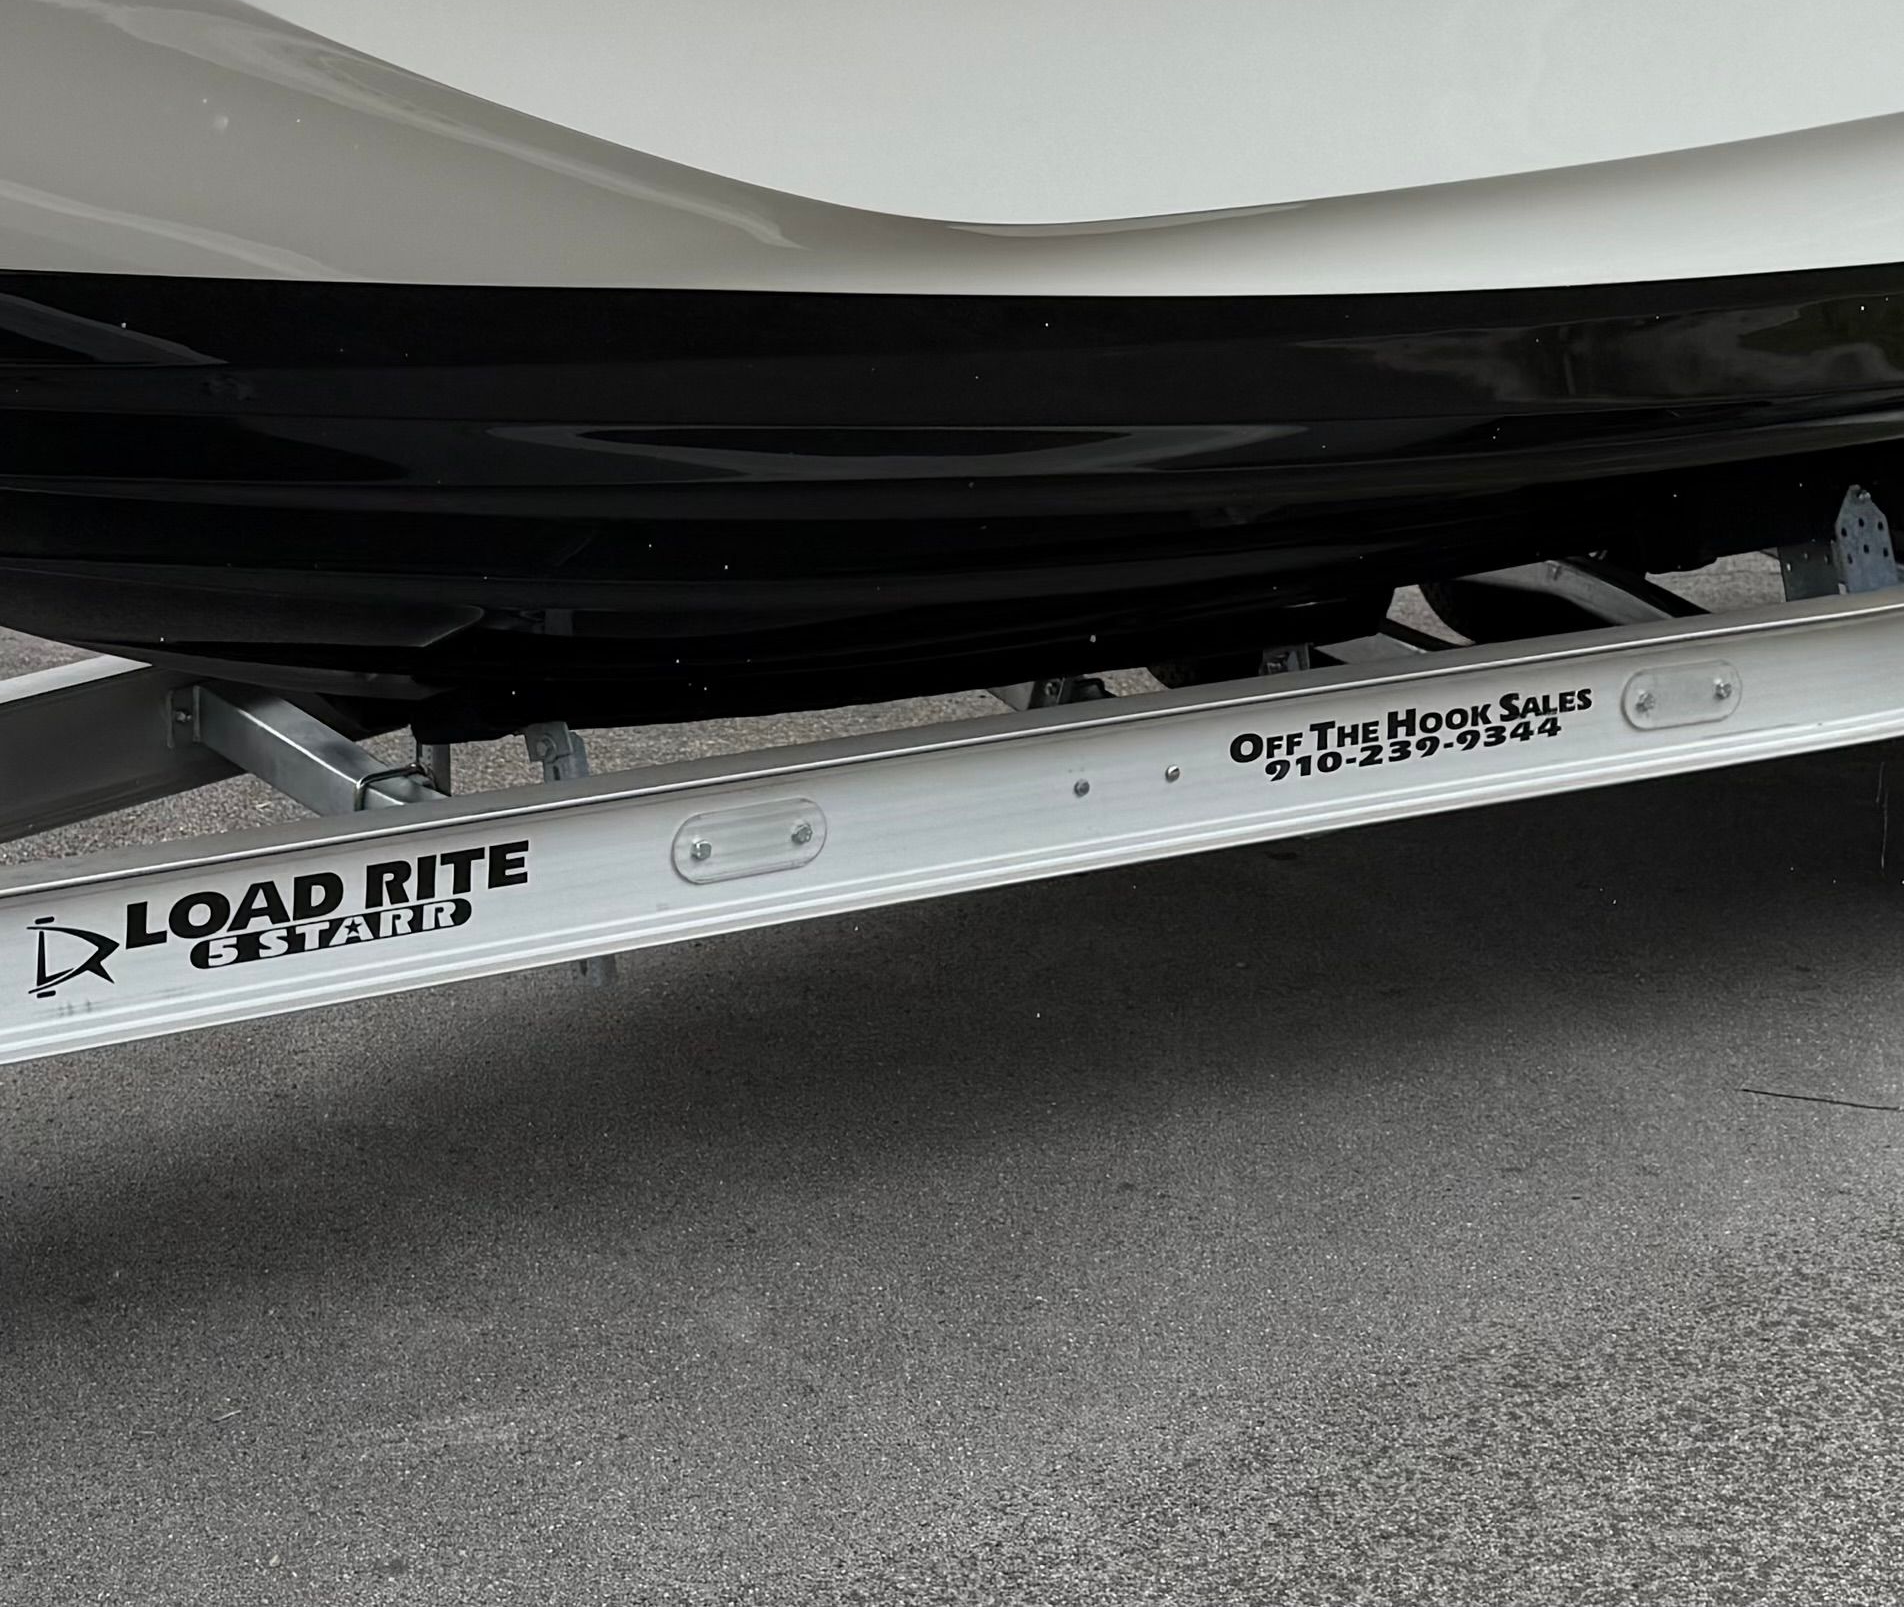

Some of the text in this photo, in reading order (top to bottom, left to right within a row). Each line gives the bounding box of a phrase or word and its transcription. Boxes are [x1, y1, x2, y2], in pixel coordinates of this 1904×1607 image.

[1230, 689, 1593, 764] OFF THE HOOK SALES
[1265, 717, 1562, 782] 910-239-9344
[126, 840, 529, 950] LOAD RITE
[208, 901, 458, 967] 5 STARR
